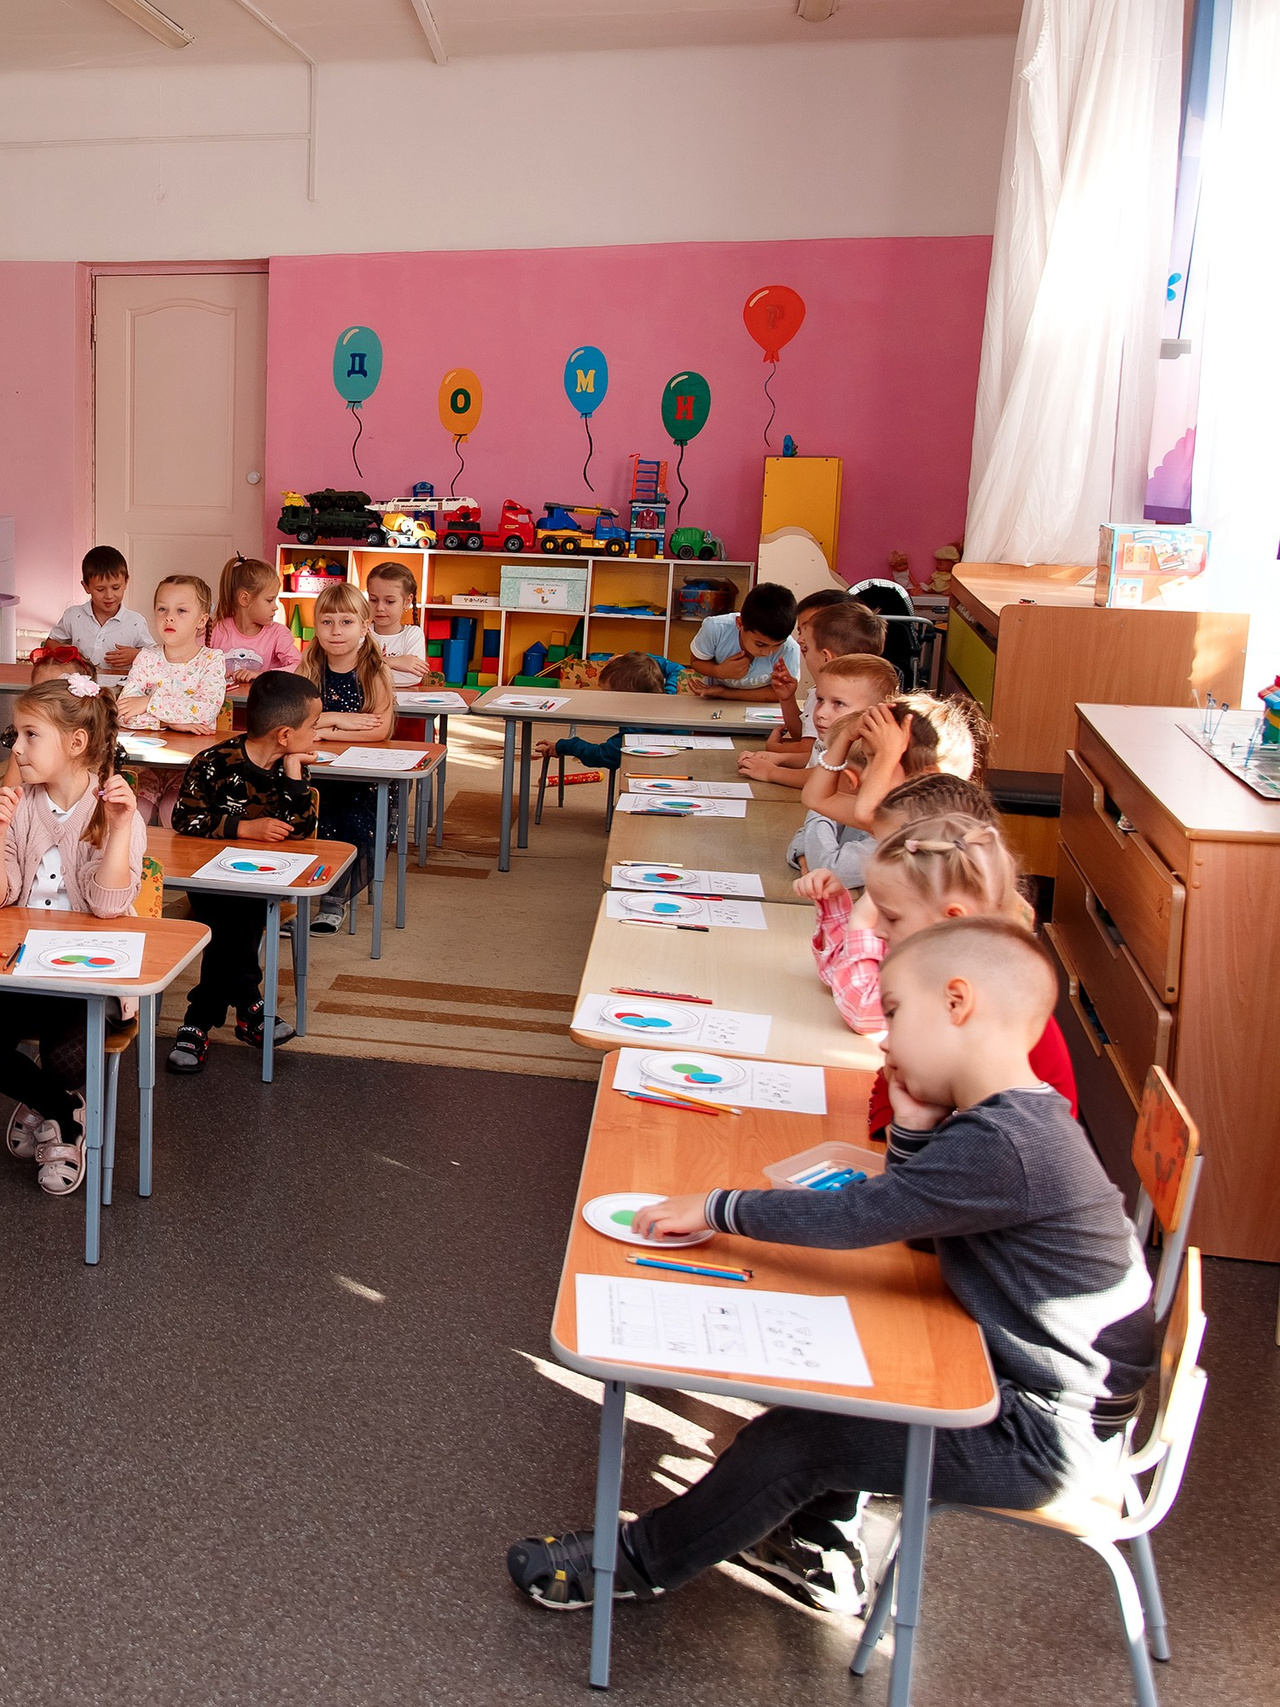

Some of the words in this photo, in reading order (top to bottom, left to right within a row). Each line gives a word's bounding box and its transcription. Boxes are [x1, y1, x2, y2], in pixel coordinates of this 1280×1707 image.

[347, 352, 368, 378] Д
[575, 369, 595, 394] М
[675, 395, 695, 421] И
